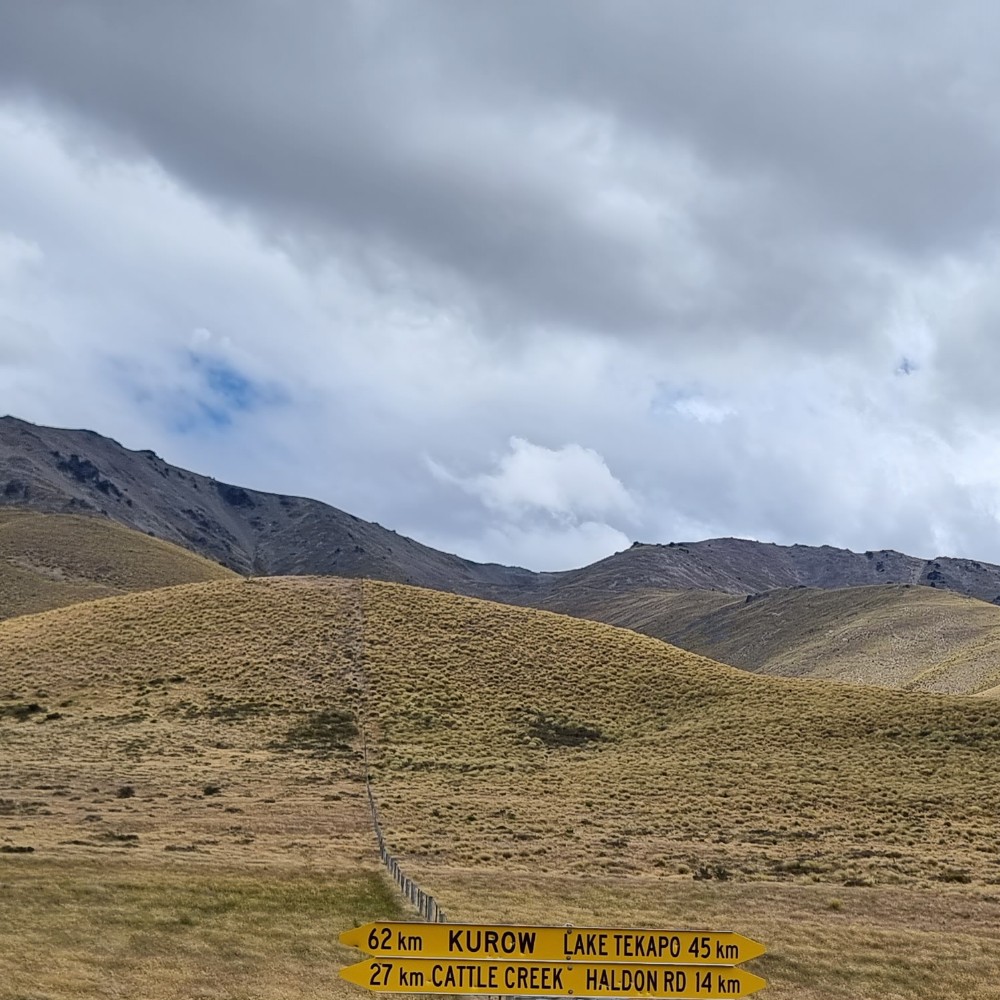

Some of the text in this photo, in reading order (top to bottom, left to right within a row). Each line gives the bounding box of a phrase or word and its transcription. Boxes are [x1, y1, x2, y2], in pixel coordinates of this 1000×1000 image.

[368, 928, 536, 954] 62 km KUROW
[564, 933, 739, 960] LAKE TEKAPO 45 km
[370, 963, 563, 990] 27 km CATTLE CREEK
[586, 968, 741, 994] HALDON RD 14 km
